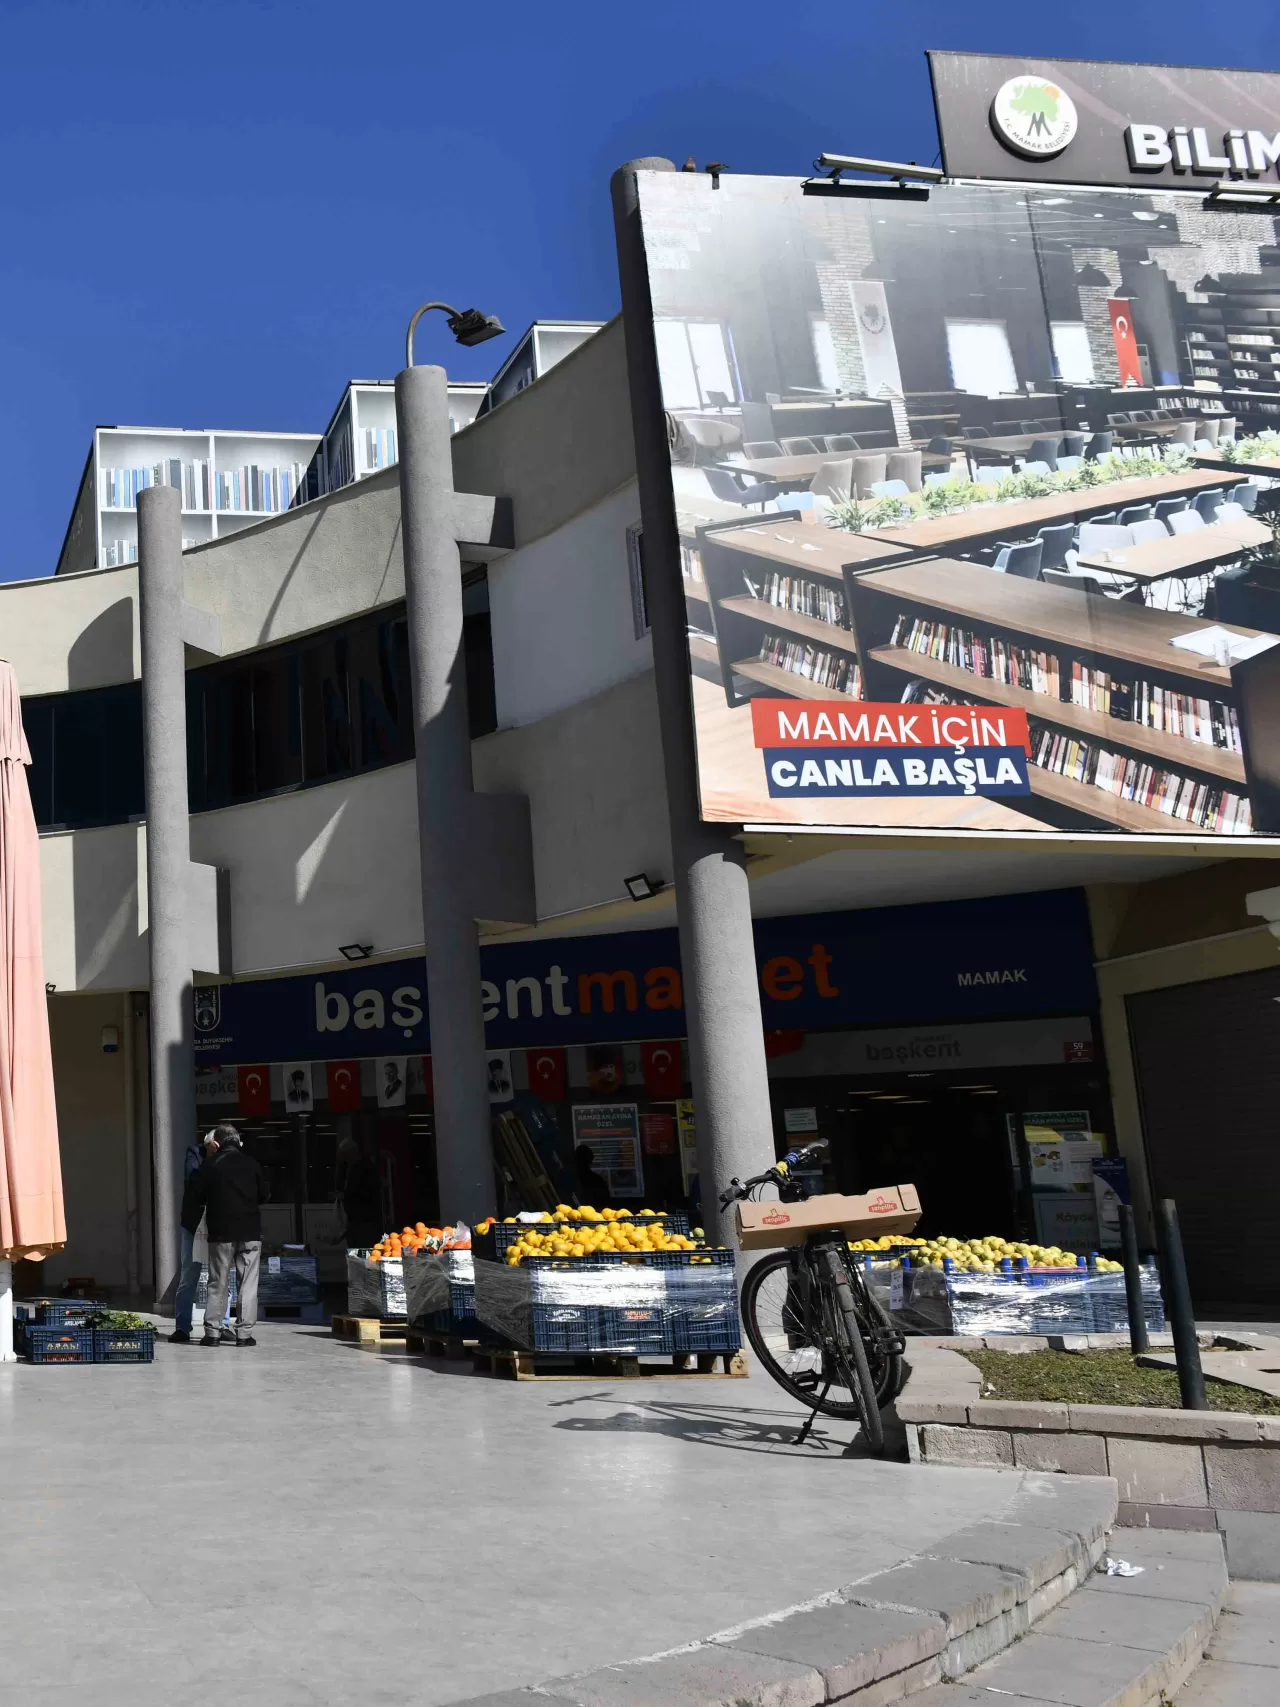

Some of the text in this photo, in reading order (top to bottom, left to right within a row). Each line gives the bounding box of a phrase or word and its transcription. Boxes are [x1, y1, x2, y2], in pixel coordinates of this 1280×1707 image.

[1012, 132, 1042, 149] MAMAK
[778, 709, 1007, 754] MAMAK İÇİN
[771, 757, 1022, 795] CANLA BAŞLA
[958, 969, 1027, 987] MAMAK
